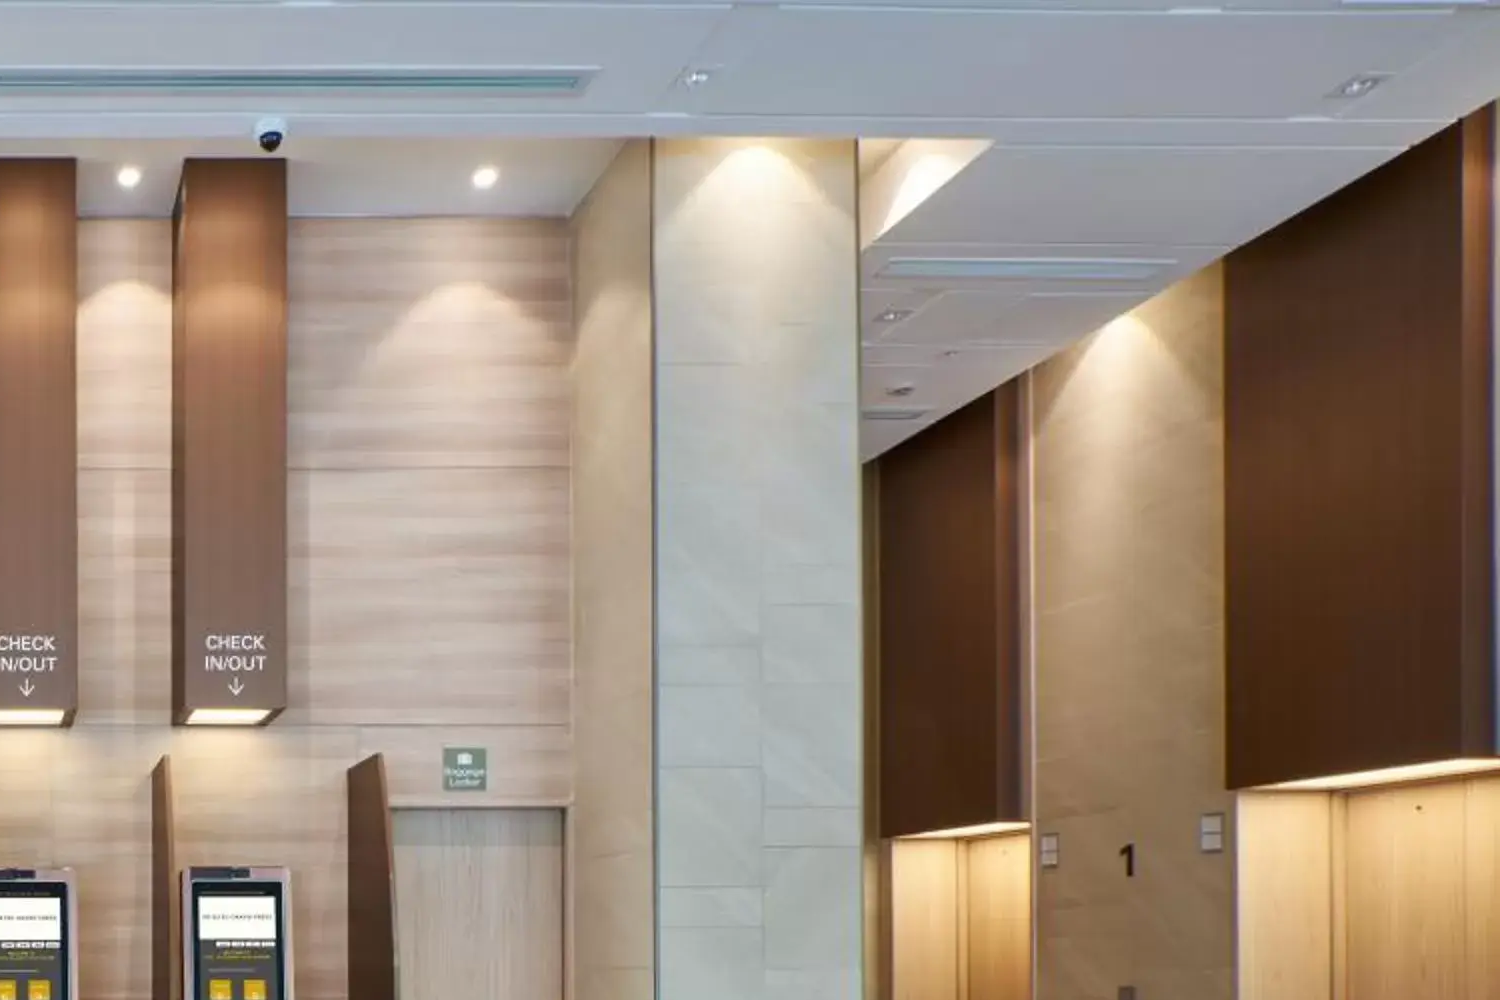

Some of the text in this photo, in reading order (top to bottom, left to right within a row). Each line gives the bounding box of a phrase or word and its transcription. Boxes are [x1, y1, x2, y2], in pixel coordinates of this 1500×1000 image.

[205, 635, 265, 651] CHECK
[204, 655, 267, 671] IN/OUT
[1119, 843, 1135, 877] 1
